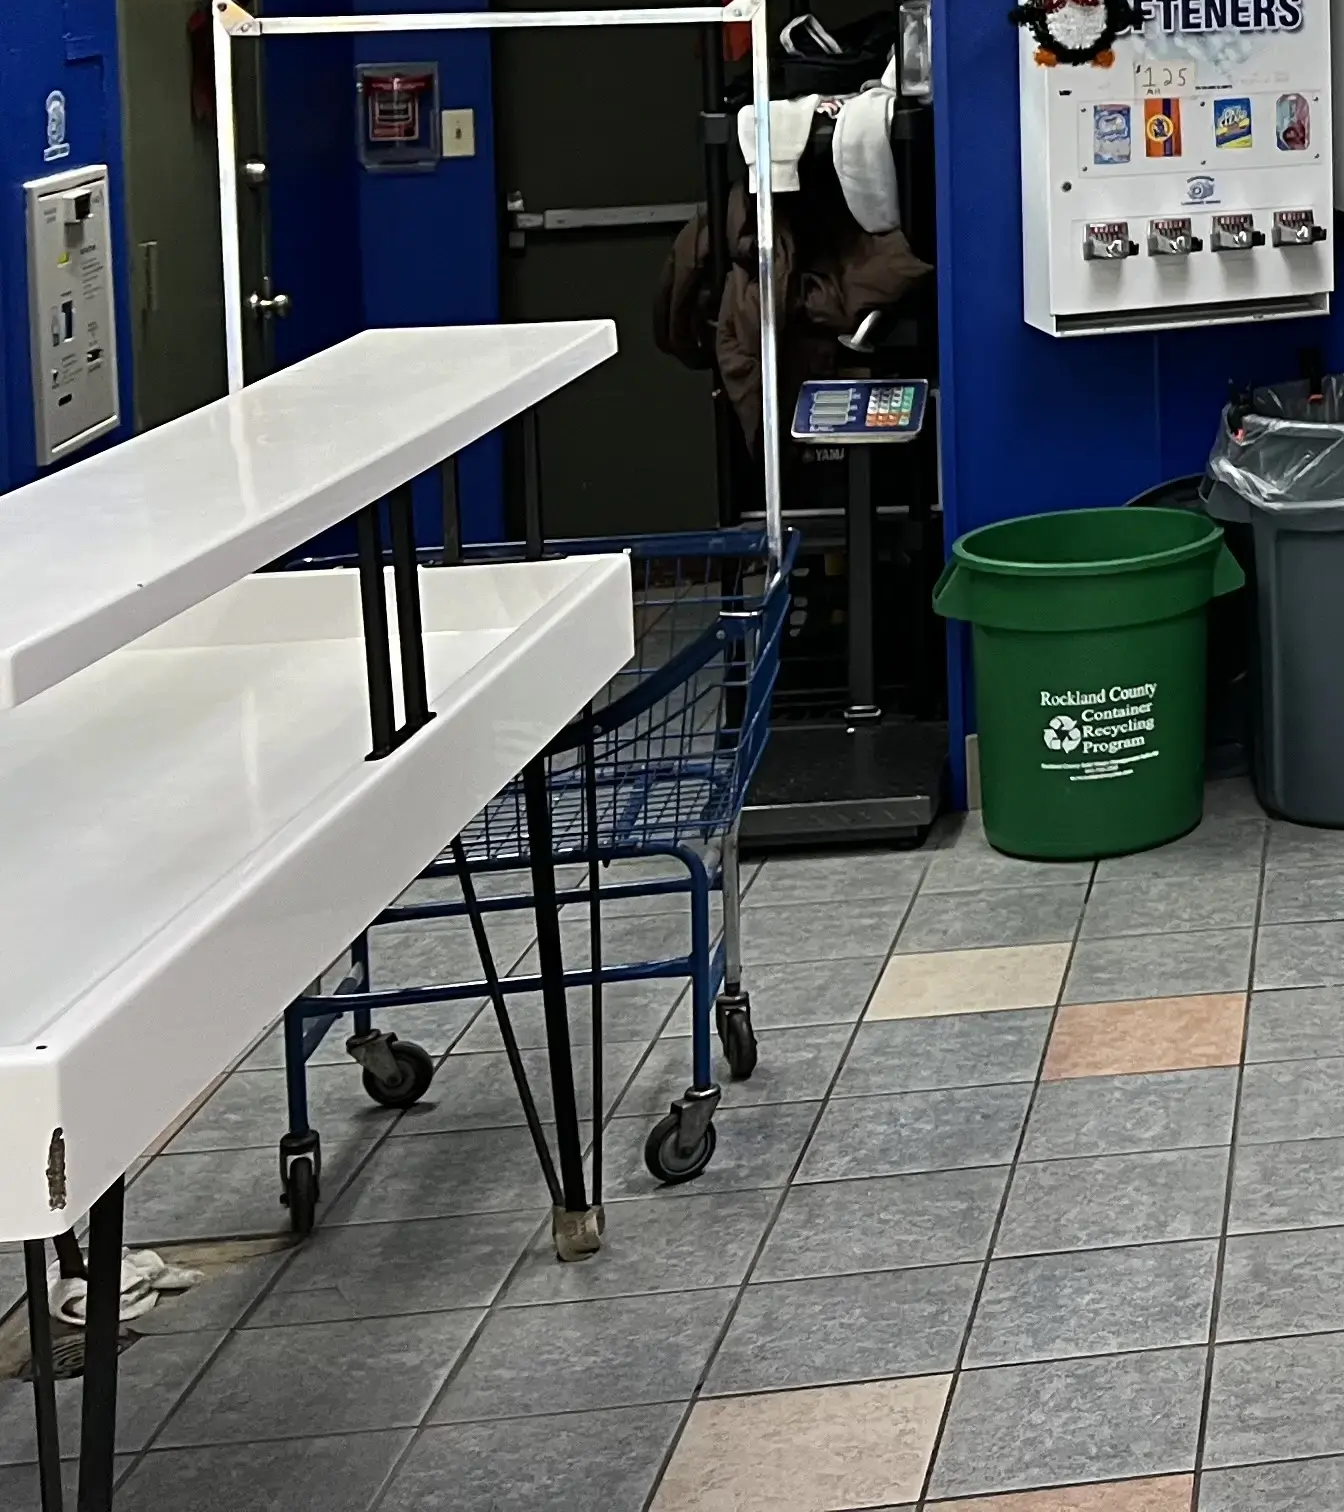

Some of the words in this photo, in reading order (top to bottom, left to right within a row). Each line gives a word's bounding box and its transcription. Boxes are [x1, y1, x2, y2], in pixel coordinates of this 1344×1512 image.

[1040, 688, 1106, 706] Rockland
[1109, 683, 1157, 702] County
[1081, 702, 1153, 722] Container
[1082, 718, 1155, 738] Recycling
[1082, 736, 1145, 754] Program
